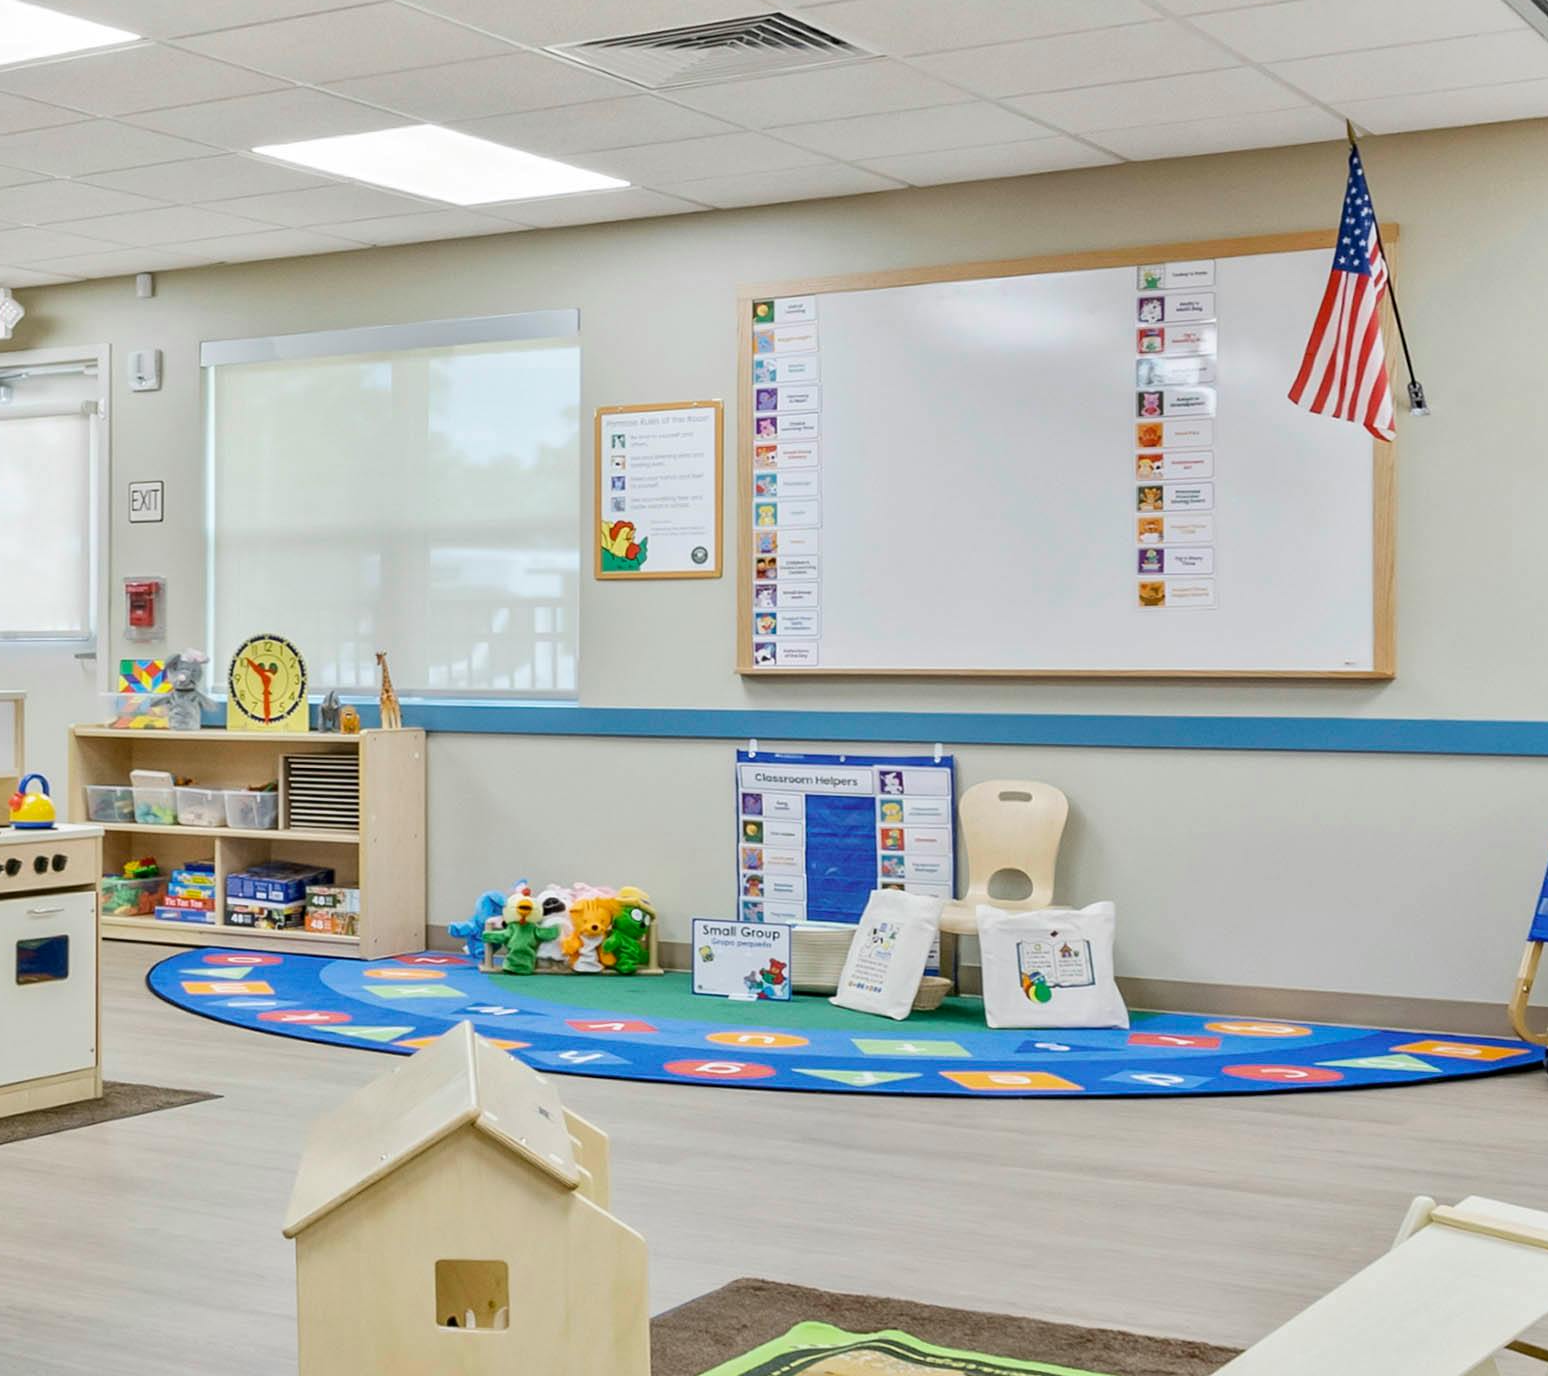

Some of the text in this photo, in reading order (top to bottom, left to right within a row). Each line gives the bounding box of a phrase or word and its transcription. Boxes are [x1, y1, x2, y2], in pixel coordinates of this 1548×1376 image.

[131, 489, 160, 512] EXIT
[755, 773, 858, 788] Classroom Helpers
[703, 925, 781, 941] Small Group
